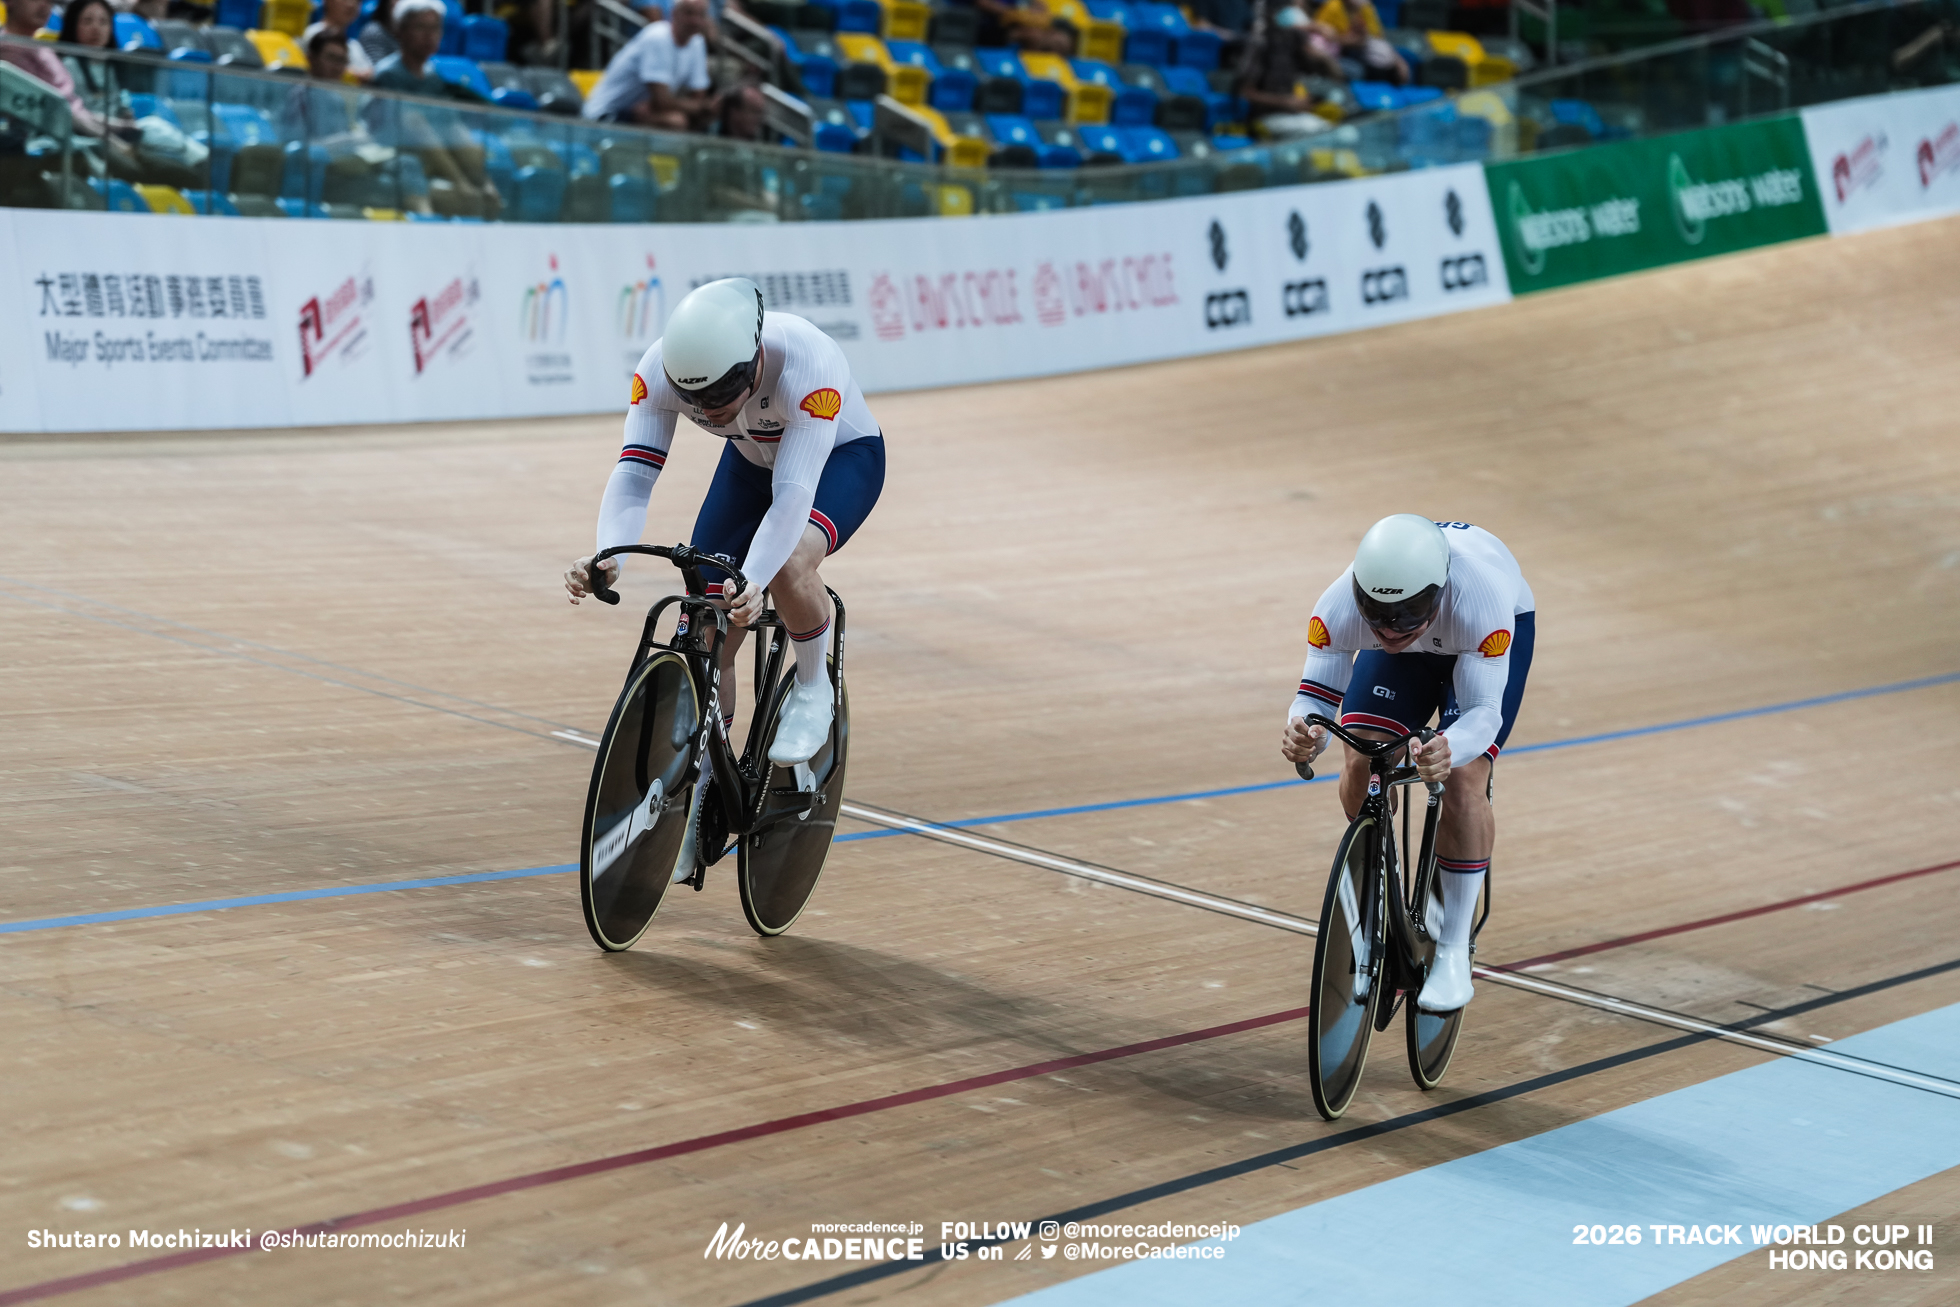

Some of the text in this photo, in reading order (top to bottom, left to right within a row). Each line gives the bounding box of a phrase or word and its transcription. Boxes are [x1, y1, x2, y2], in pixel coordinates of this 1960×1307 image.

[45, 330, 90, 369] Major
[94, 330, 146, 370] Sports
[147, 330, 195, 362] Events
[197, 330, 275, 362] Committee
[677, 376, 709, 385] LAZER
[1371, 586, 1404, 595] LAZER
[693, 667, 721, 770] LOTUS
